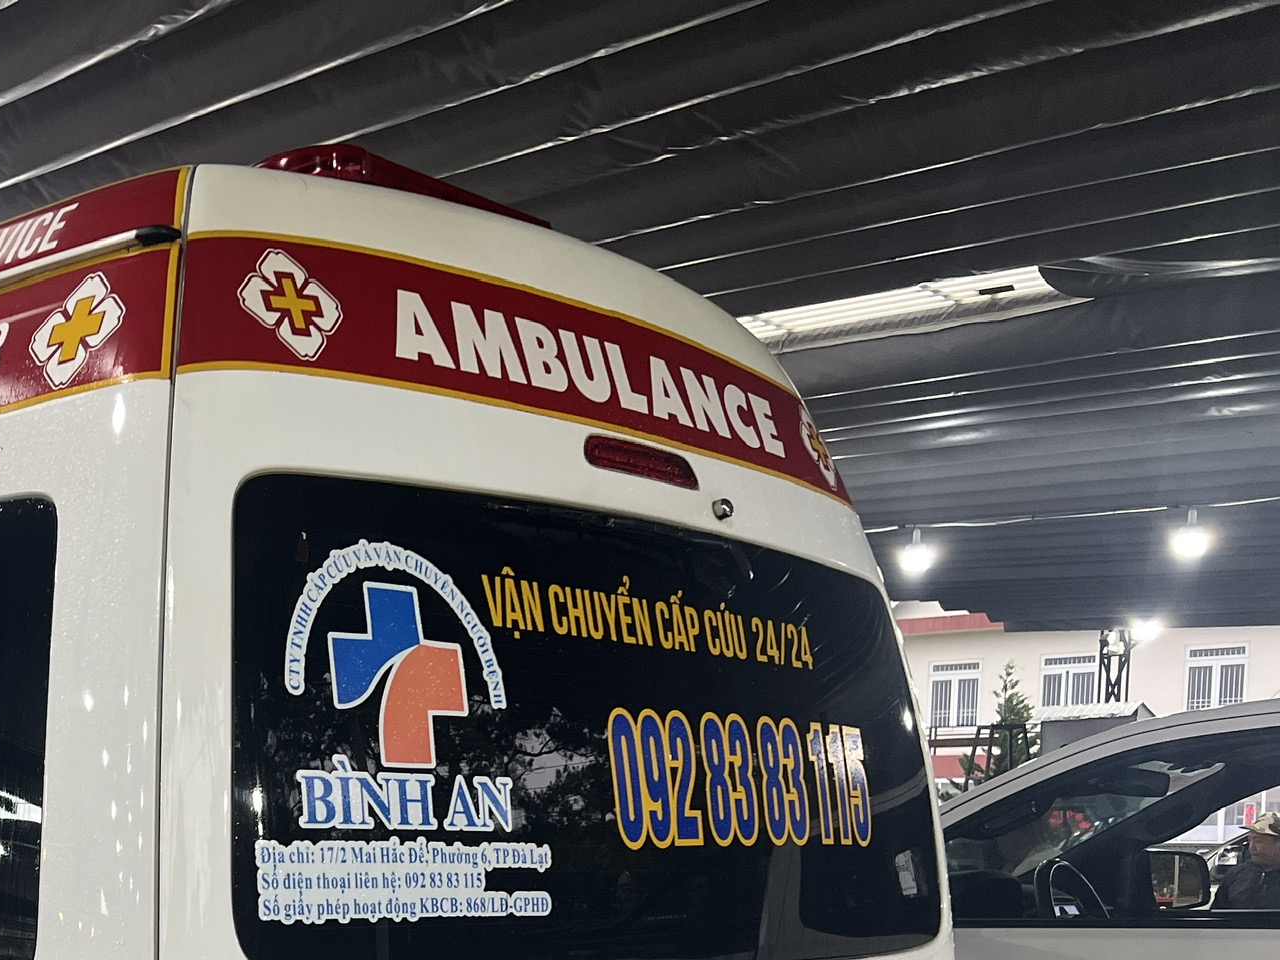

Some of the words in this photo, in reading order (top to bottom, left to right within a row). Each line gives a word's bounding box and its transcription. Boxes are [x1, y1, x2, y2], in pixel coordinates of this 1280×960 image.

[395, 289, 786, 458] AMBULANCE
[290, 602, 313, 649] TNHH
[481, 566, 545, 639] VẬN
[548, 575, 654, 647] CHUYỂN
[655, 589, 700, 652] CẤP
[751, 616, 814, 670] 24/24
[288, 653, 302, 690] CTY
[300, 760, 434, 827] BÌNH
[447, 777, 510, 829] AN
[607, 706, 705, 850] 092
[699, 711, 759, 848] 83
[756, 715, 810, 847] 83
[806, 721, 872, 848] 115
[261, 846, 285, 868] Địa
[289, 846, 315, 864] chỉ:
[319, 846, 347, 864] 17/2
[351, 846, 377, 864] Mai
[380, 842, 405, 864] Hắc
[432, 846, 479, 868] Phường
[480, 847, 491, 866] 6,
[493, 847, 509, 864] TP
[512, 846, 527, 864] Đà
[530, 847, 549, 868] Lạt
[283, 871, 313, 892] điện
[316, 872, 351, 894] thoại
[354, 871, 379, 889] liên
[382, 871, 402, 894] hệ:
[404, 871, 426, 889] 092
[429, 872, 443, 889] 83
[446, 872, 460, 889] 83
[463, 872, 483, 889] 115
[262, 894, 281, 917] Số
[284, 894, 313, 919] giấy
[317, 898, 350, 920] phép
[353, 898, 382, 918] hoạt
[385, 897, 417, 919] động
[419, 897, 463, 914] KBCB:
